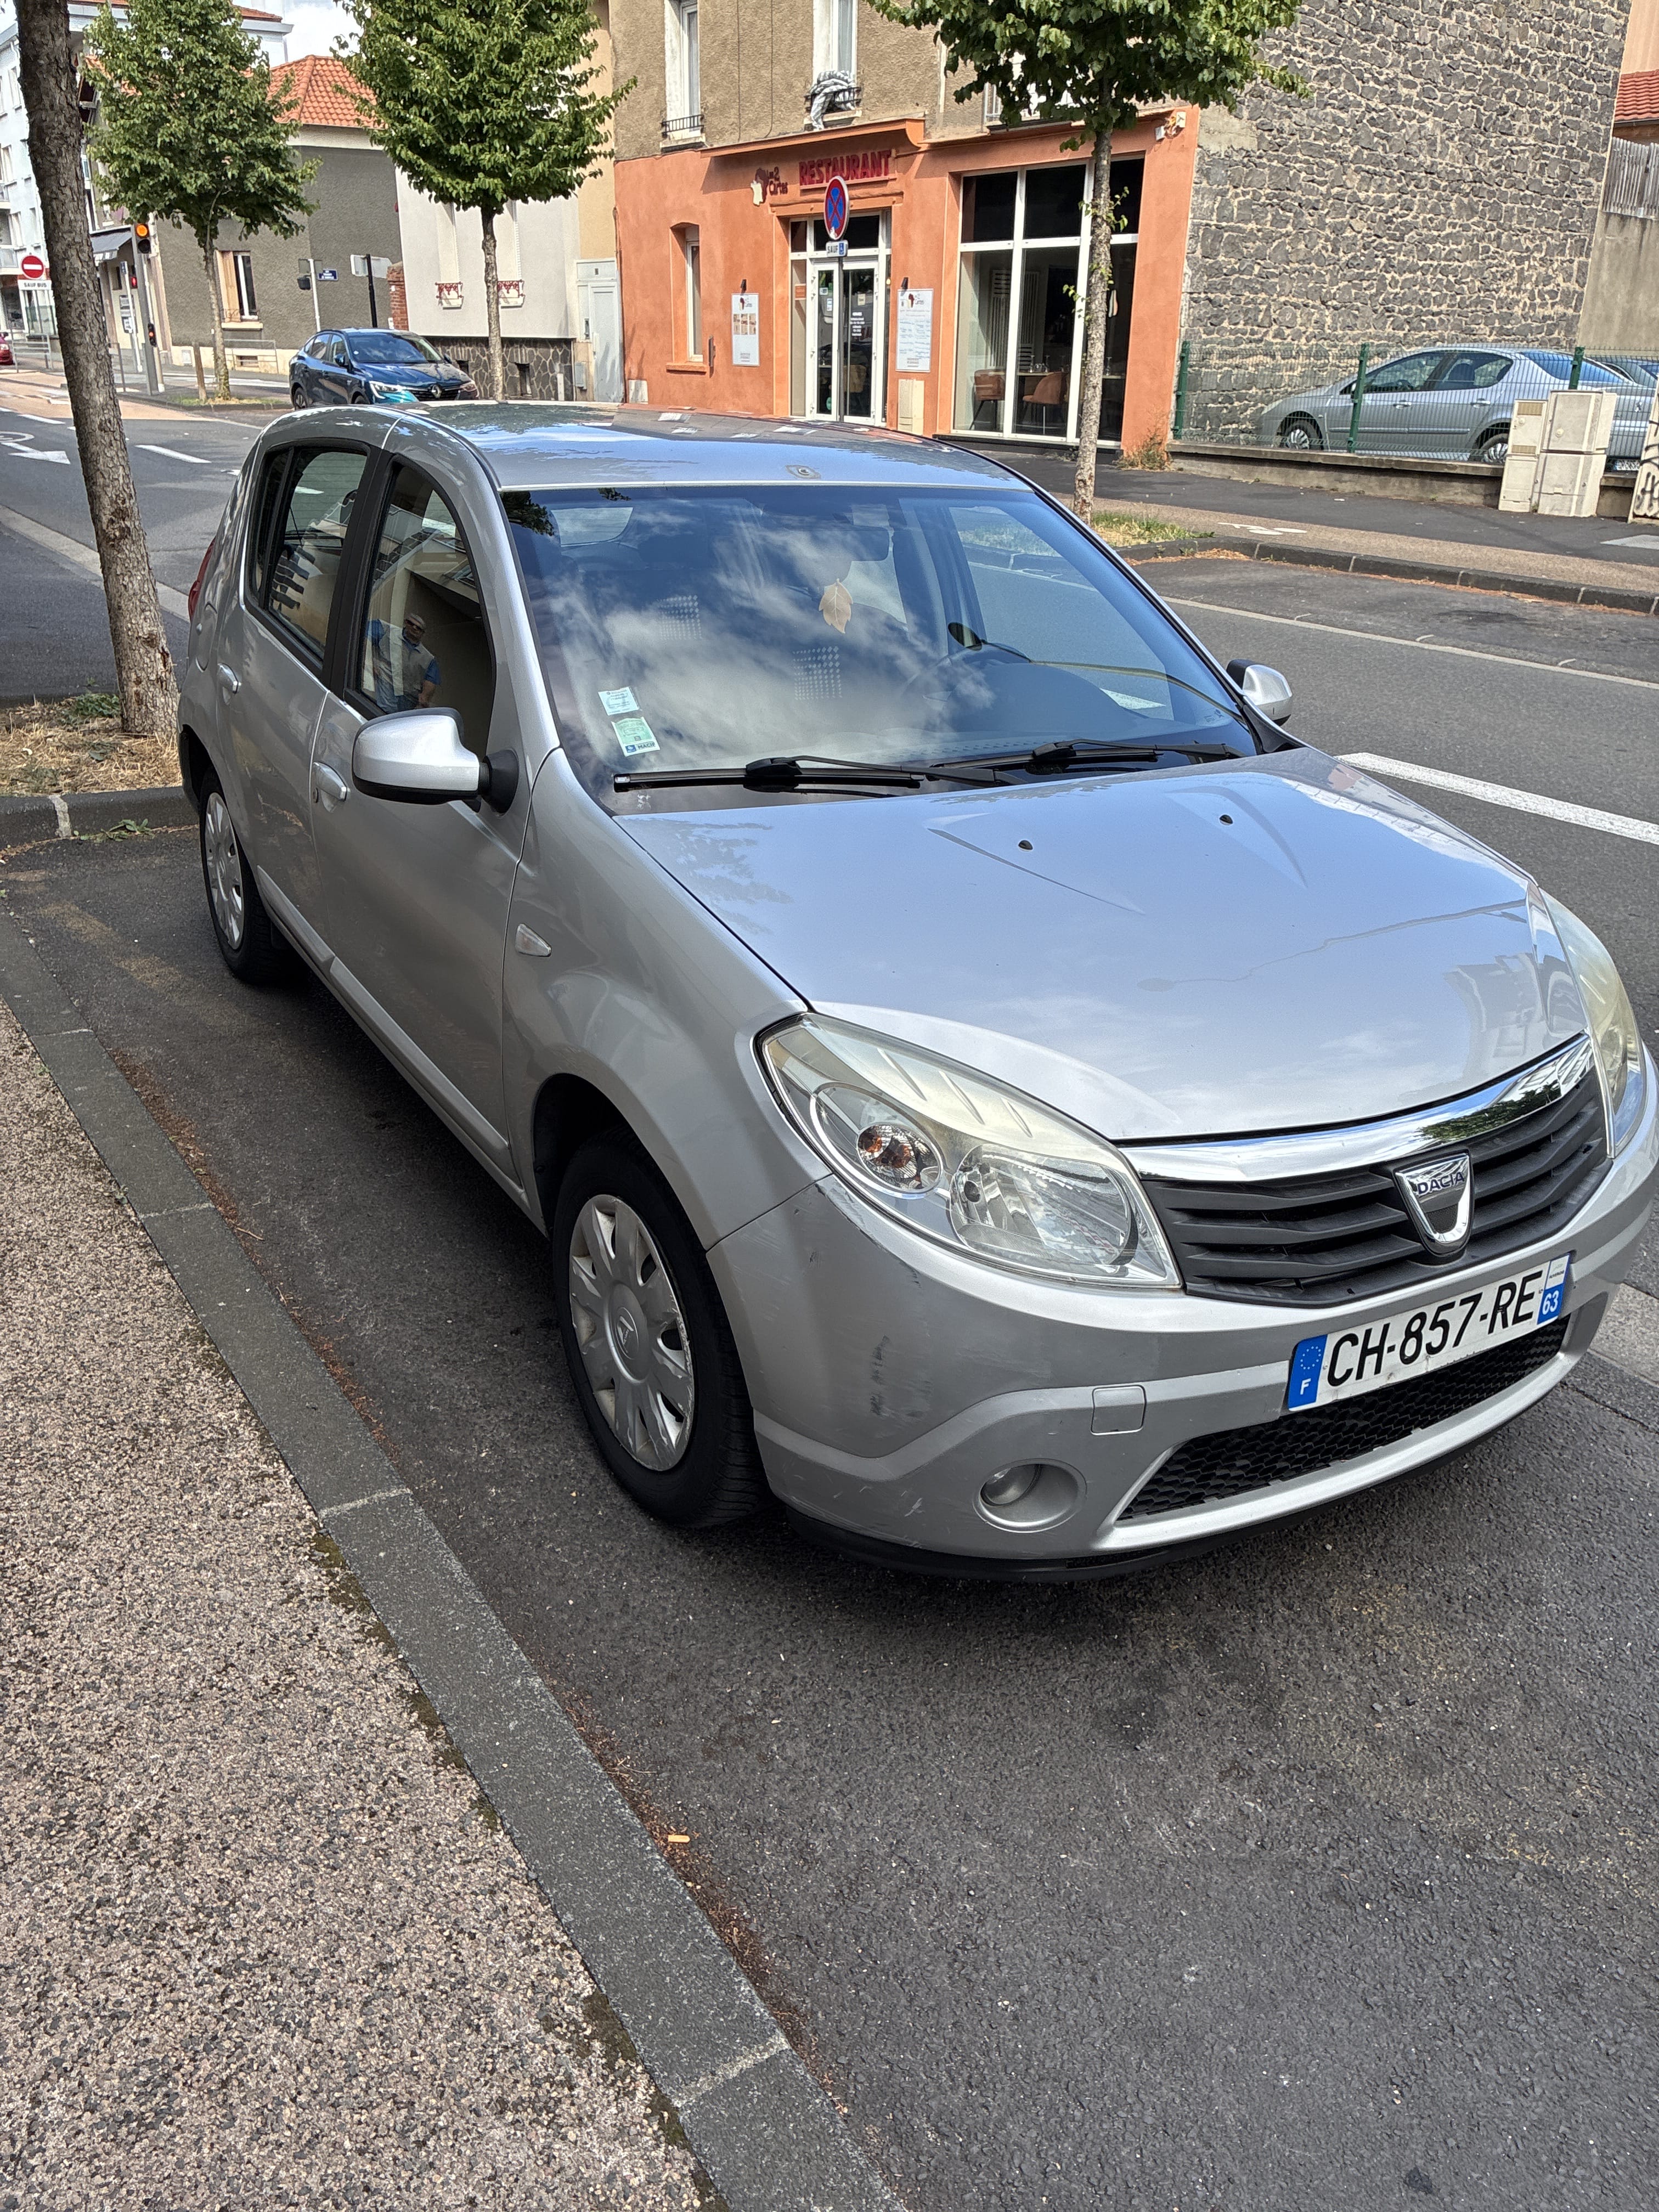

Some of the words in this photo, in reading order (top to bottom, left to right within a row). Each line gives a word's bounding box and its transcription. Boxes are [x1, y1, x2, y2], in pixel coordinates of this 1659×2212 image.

[799, 150, 891, 186] RESTAURANT
[827, 245, 838, 253] SAUF
[1417, 1171, 1465, 1195] DACIA
[1542, 1290, 1559, 1315] 63
[1327, 1270, 1543, 1387] CH-857-RE
[1300, 1378, 1311, 1395] F
